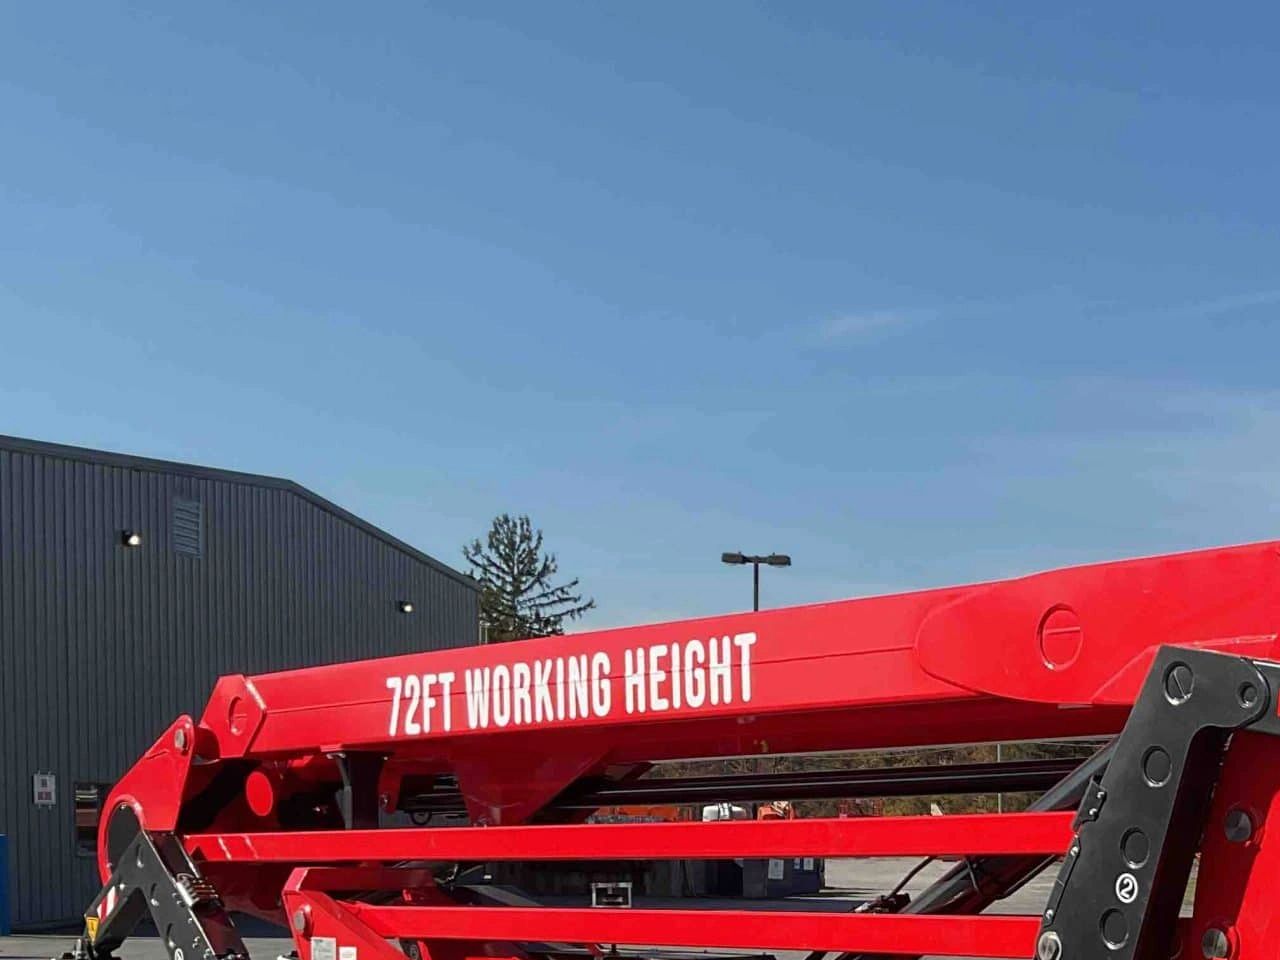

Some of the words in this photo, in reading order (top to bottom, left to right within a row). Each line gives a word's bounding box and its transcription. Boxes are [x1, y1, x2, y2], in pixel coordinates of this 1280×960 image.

[386, 671, 455, 737] 72FT
[464, 651, 612, 730] WORKING
[624, 632, 757, 714] HEIGHT
[1118, 876, 1134, 900] 2
